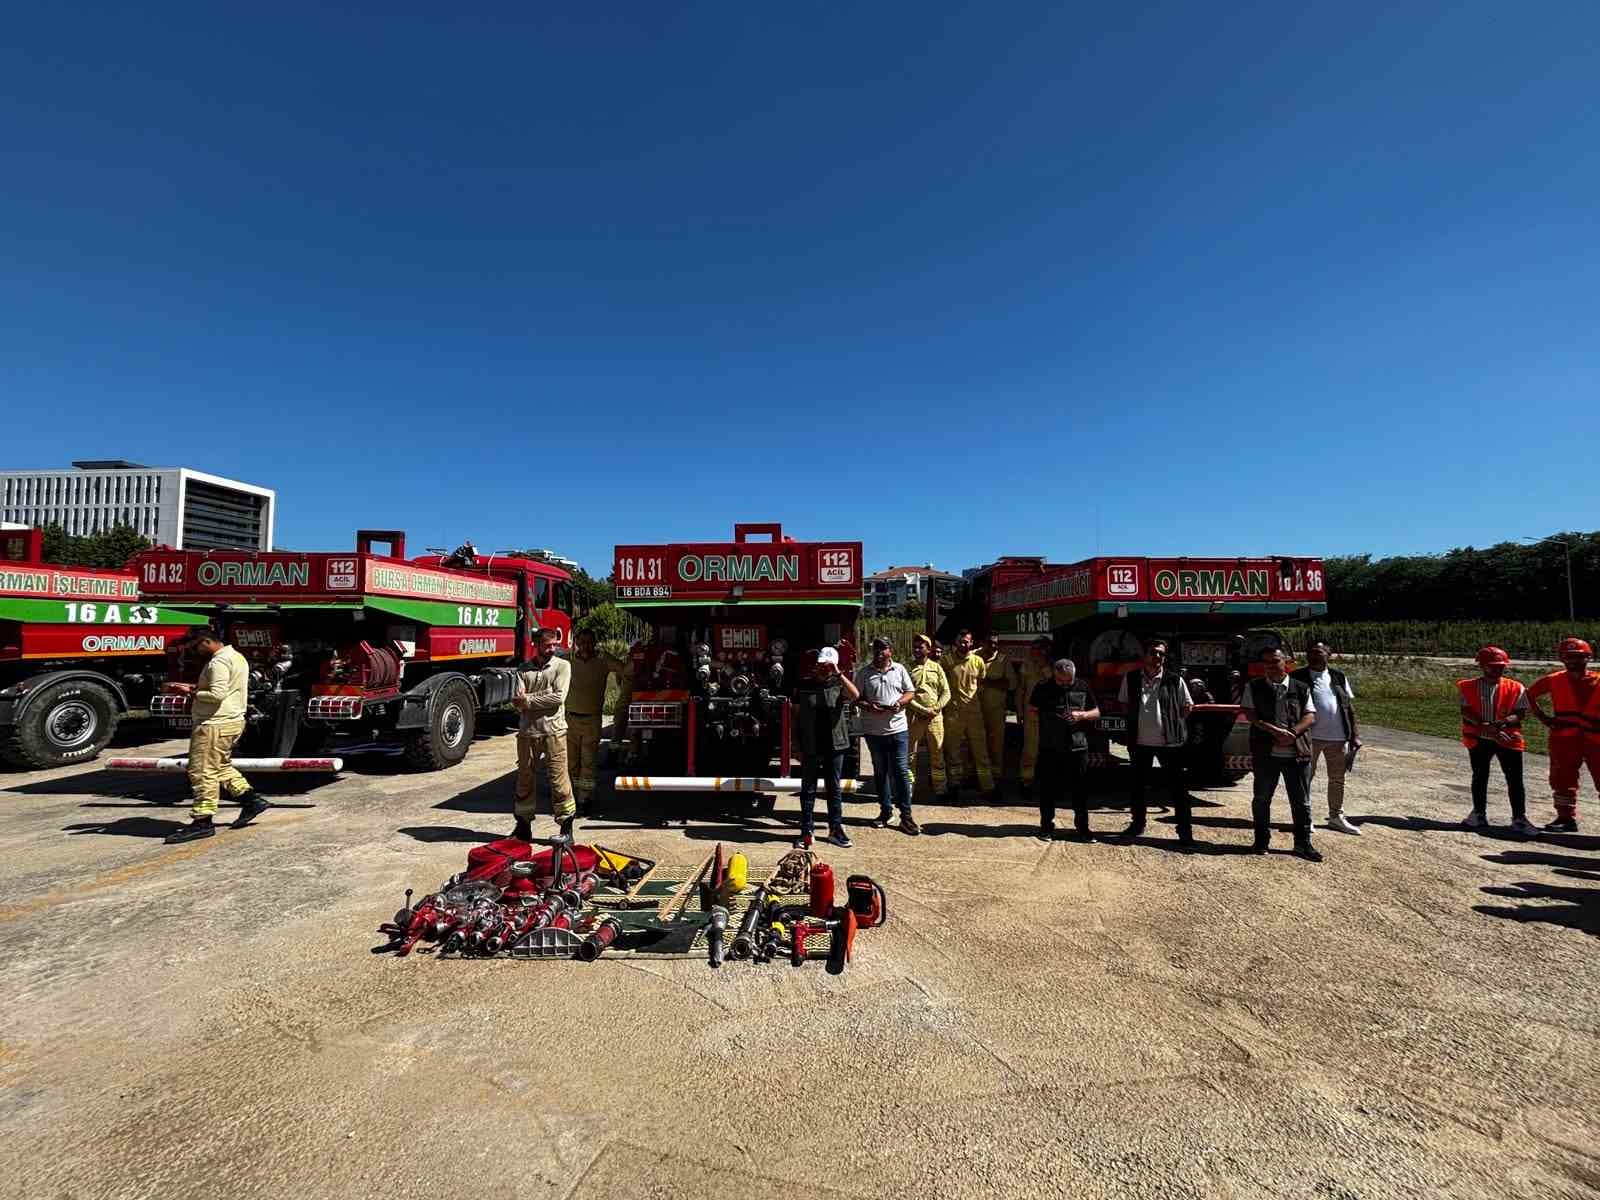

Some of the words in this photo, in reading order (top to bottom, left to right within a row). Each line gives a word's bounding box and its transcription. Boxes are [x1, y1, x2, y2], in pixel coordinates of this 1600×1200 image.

[331, 561, 354, 574] 112
[619, 558, 634, 580] 16
[637, 558, 645, 580] A
[648, 558, 662, 580] 31
[678, 555, 799, 582] ORMAN
[823, 552, 849, 566] 112
[143, 562, 156, 583] 16
[158, 563, 167, 583] A
[169, 562, 183, 583] 32
[197, 561, 310, 586] ORMAN
[1112, 569, 1132, 583] 112
[1295, 568, 1304, 591] A
[1307, 570, 1322, 591] 36
[623, 587, 632, 597] 16
[1155, 570, 1270, 597] ORMAN
[65, 603, 96, 623] 16
[104, 604, 122, 624] A
[129, 604, 158, 624] 33
[457, 606, 471, 625] 16
[475, 607, 482, 625] A
[486, 608, 499, 626] 32
[1016, 612, 1026, 632] 16
[1028, 612, 1035, 632] A
[1037, 611, 1049, 632] 36
[82, 635, 165, 652] ORMAN
[459, 638, 497, 656] ORMAN
